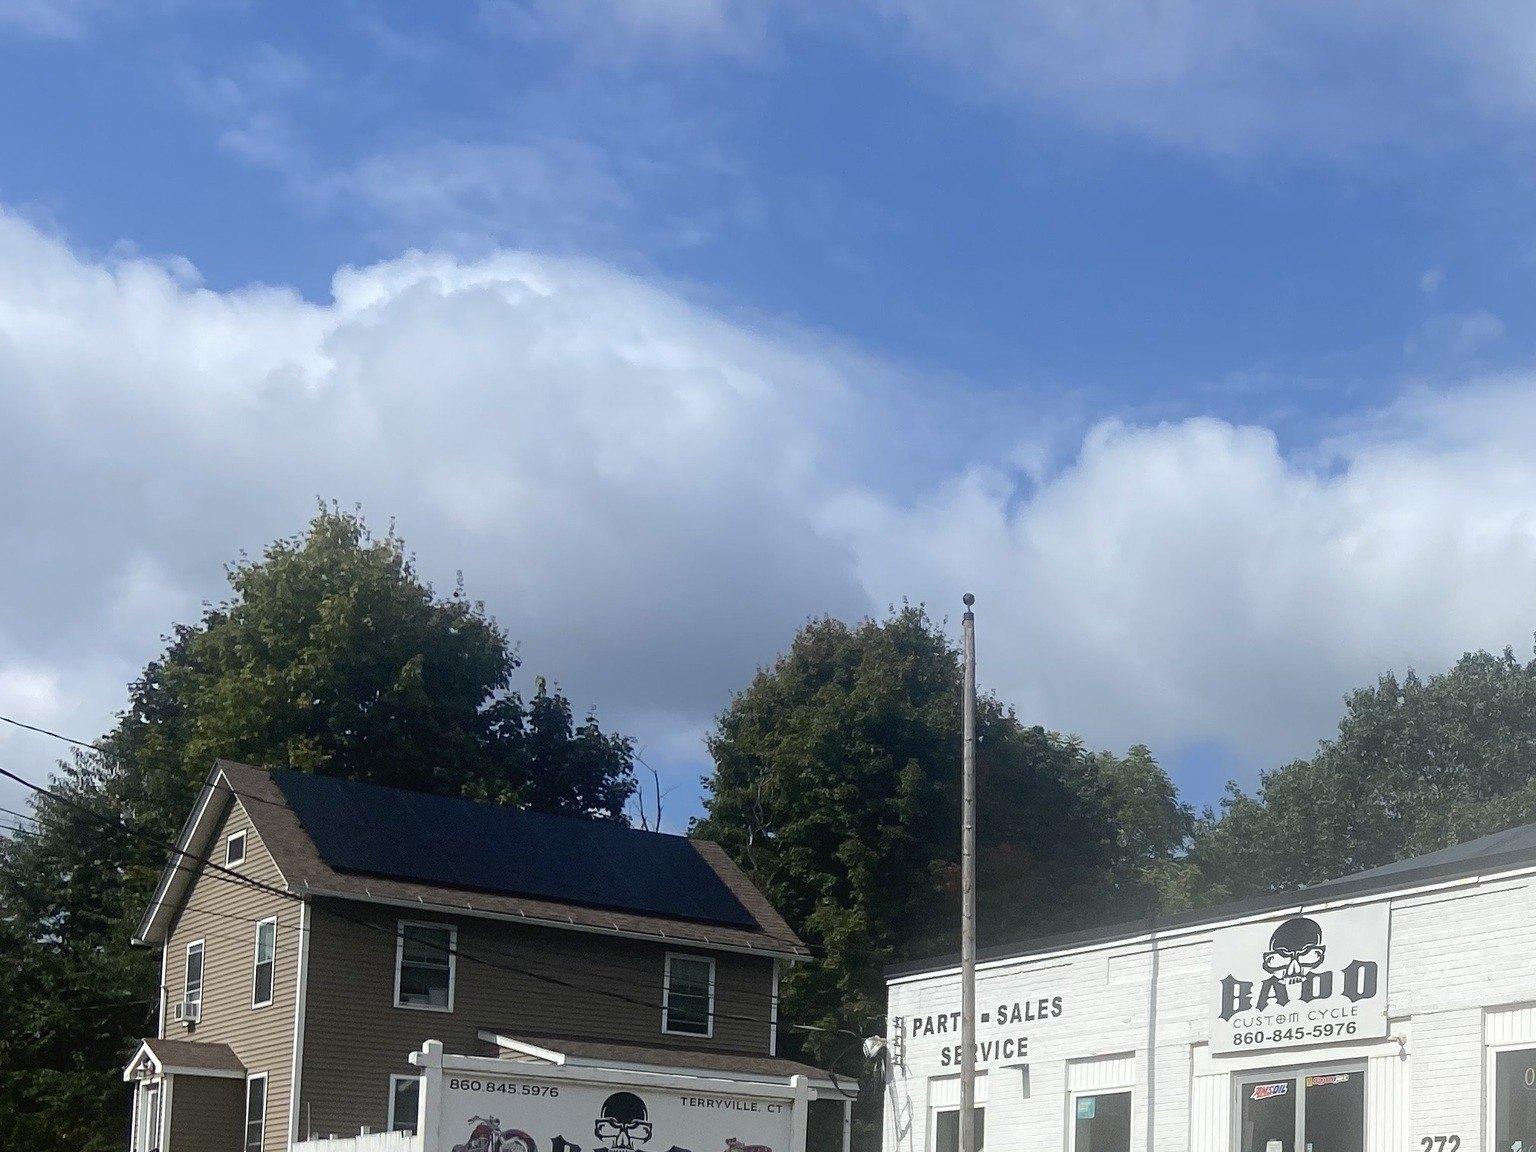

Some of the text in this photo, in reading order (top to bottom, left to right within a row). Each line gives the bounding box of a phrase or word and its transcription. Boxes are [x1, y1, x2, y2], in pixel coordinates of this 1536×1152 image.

[1218, 959, 1379, 1022] BADD
[912, 996, 1063, 1037] PART SALES
[1233, 1005, 1359, 1029] CUSTOM CYCLE
[1233, 1021, 1357, 1046] 860-845-5976
[941, 1037, 1028, 1067] SEVICE
[450, 1078, 559, 1098] 860.845.5976
[1253, 1083, 1287, 1099] AMSOIL
[681, 1097, 783, 1114] TERRYVILLE, CT
